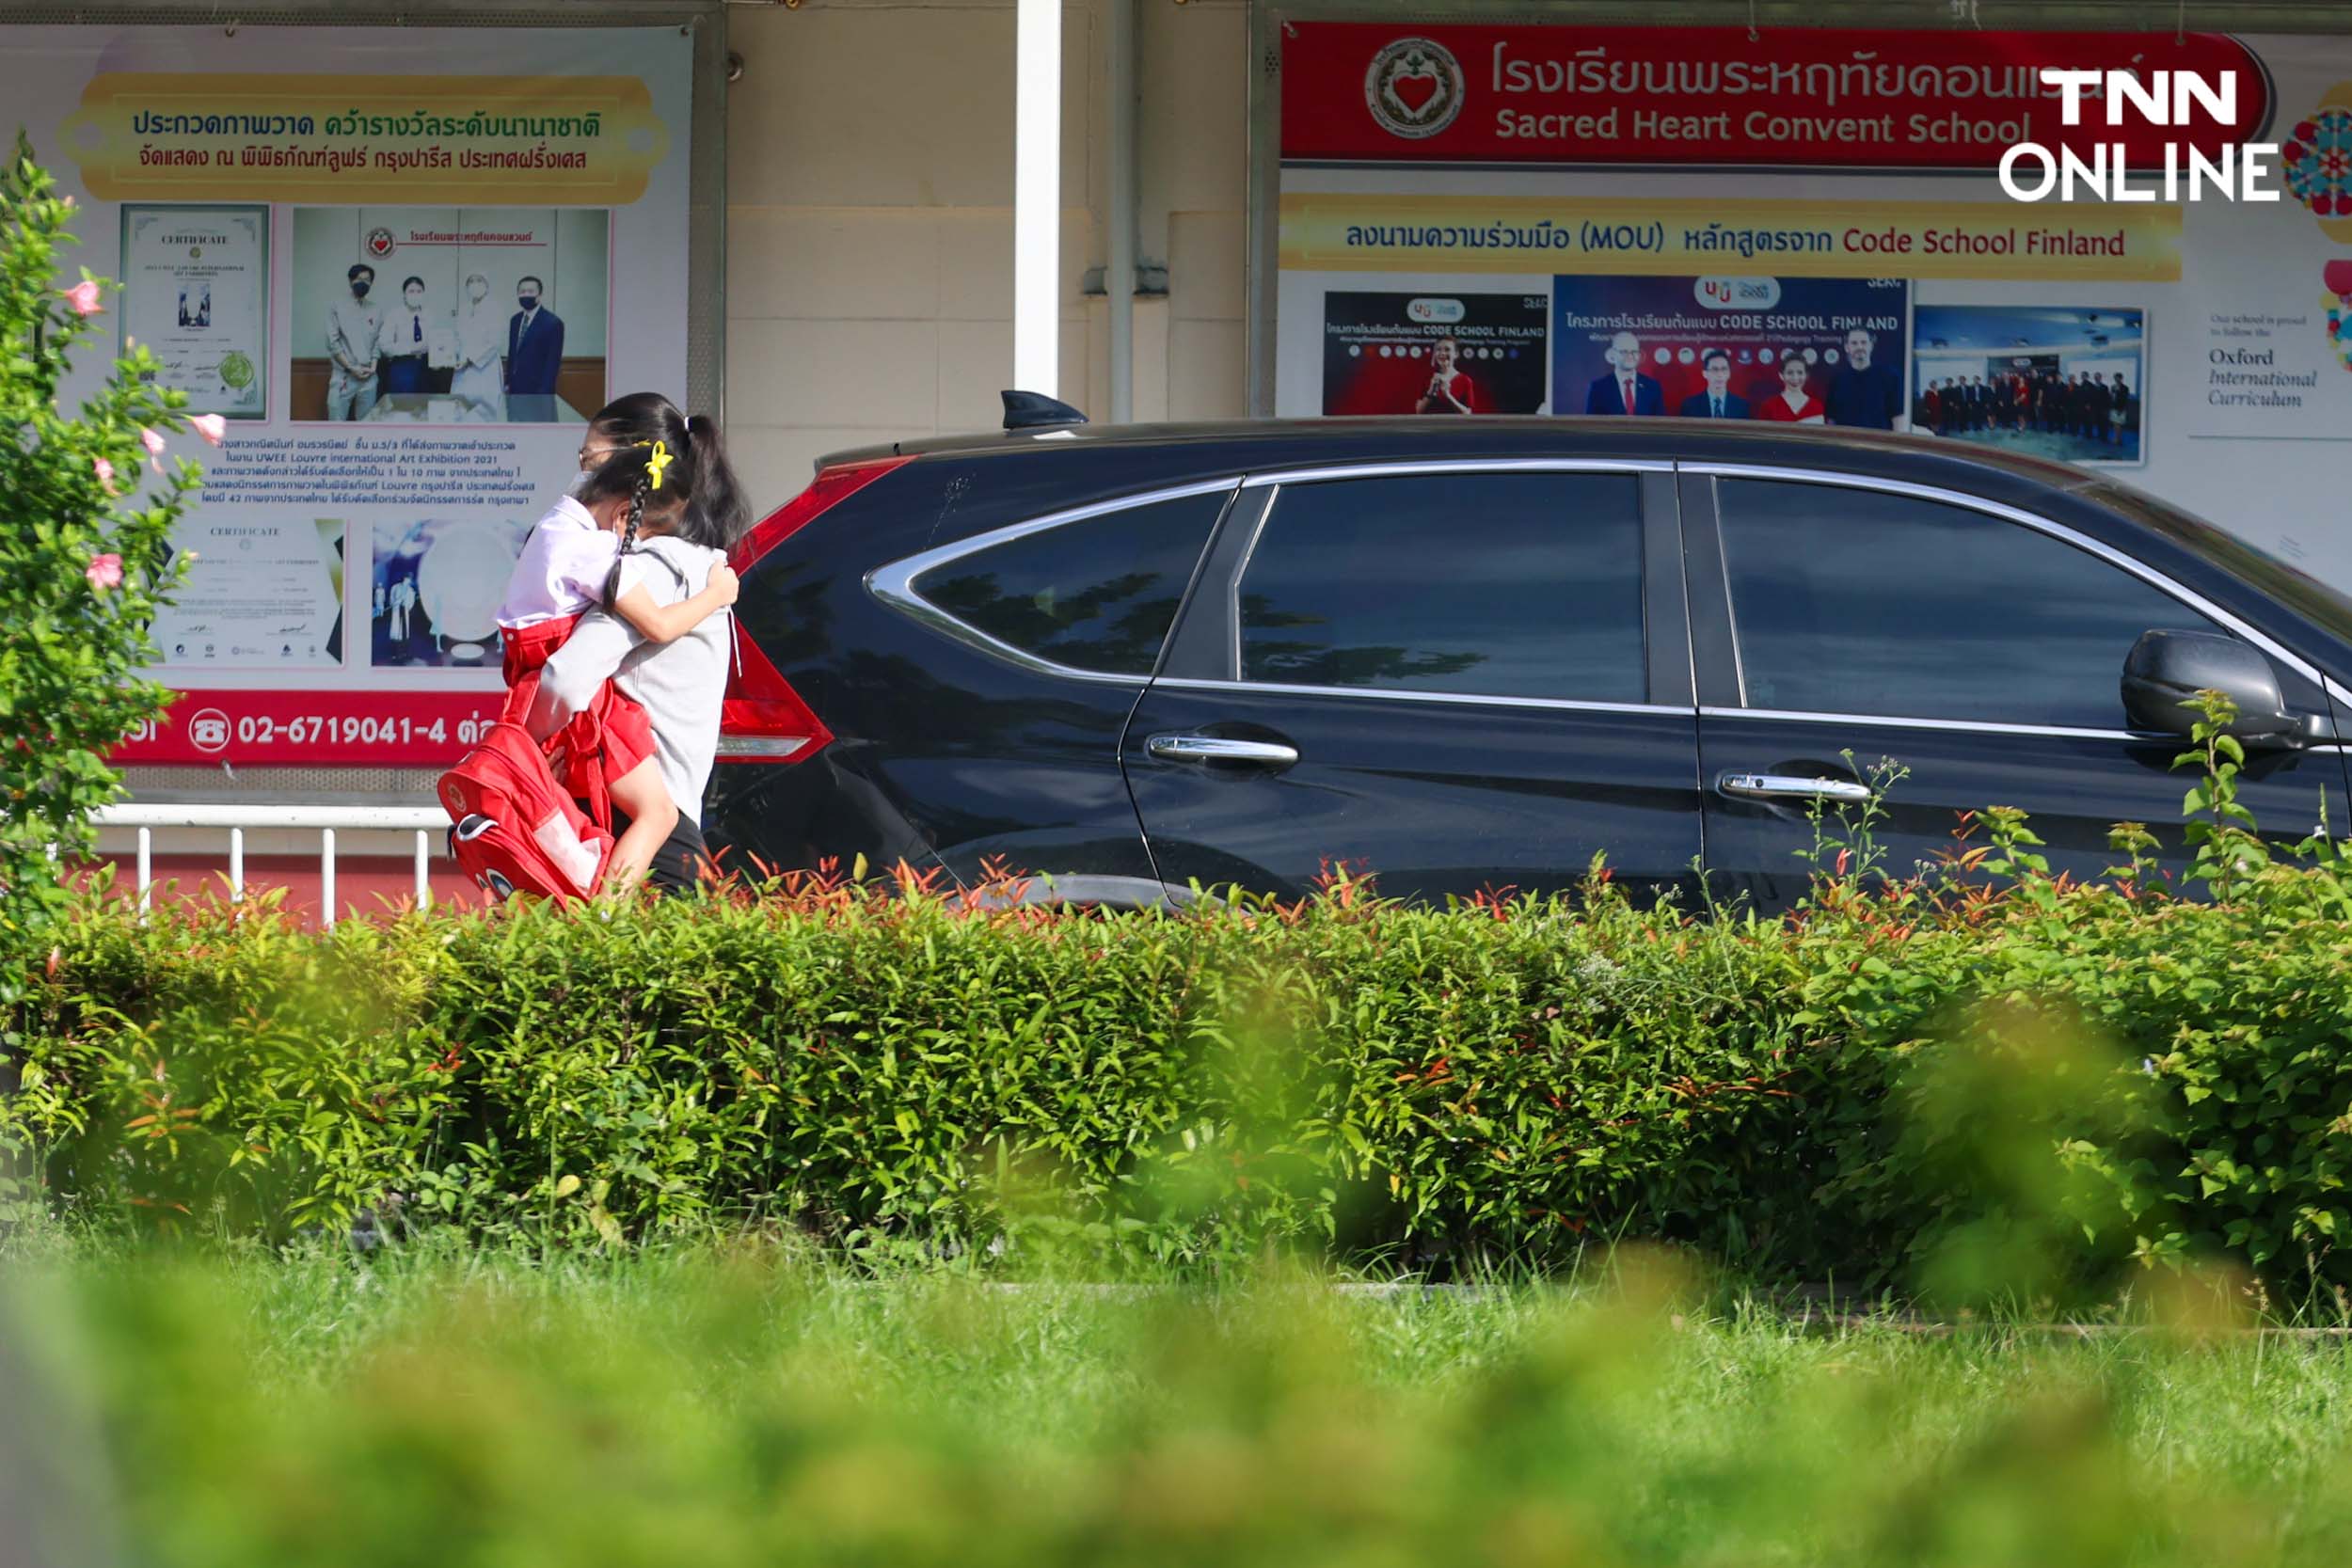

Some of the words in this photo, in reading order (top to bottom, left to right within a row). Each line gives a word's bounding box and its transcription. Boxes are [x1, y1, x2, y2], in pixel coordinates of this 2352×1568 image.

[1491, 41, 2143, 105] โรงเรียนพระหฤทัยคอนแ์
[134, 110, 313, 135] ประกวดภาพวาด
[325, 108, 601, 136] คว้ารางวัลระดับนานาชาติ
[1495, 109, 1619, 139] Sacred
[1633, 111, 1731, 140] Heart
[1744, 112, 1894, 144] Convent
[1907, 113, 2030, 144] School
[140, 144, 209, 166] จัดแสดง
[216, 149, 233, 166] ณ
[242, 144, 368, 173] พิพิธภัณฑ์ลูฟร์
[374, 145, 452, 173] กรุงปารีส
[459, 141, 586, 168] ประเทศฝรั่งเศส
[1346, 219, 1569, 249] ลงนามความร่วมมือ
[1581, 221, 1664, 252] (MOU)
[1684, 224, 1832, 259] หลักสูตรจาก
[1842, 228, 1912, 254] Code
[1922, 228, 2015, 255] School
[2026, 230, 2125, 256] Finland
[1423, 325, 1452, 336] CODE
[1454, 325, 1495, 337] SCHOOL
[1498, 326, 1545, 337] FINLAND
[1720, 315, 1762, 329] CODE
[1767, 315, 1827, 329] SCHOOL
[2209, 348, 2274, 365] Oxford
[2209, 369, 2317, 388] International
[2208, 389, 2302, 407] Curriculum
[291, 453, 326, 463] Louvre
[399, 453, 414, 464] Art
[419, 453, 470, 464] Exhibition
[474, 455, 497, 464] 2021
[381, 482, 418, 490] Louvre
[210, 528, 280, 536] CERTIFICATE
[238, 716, 447, 744] 02-6719041-4
